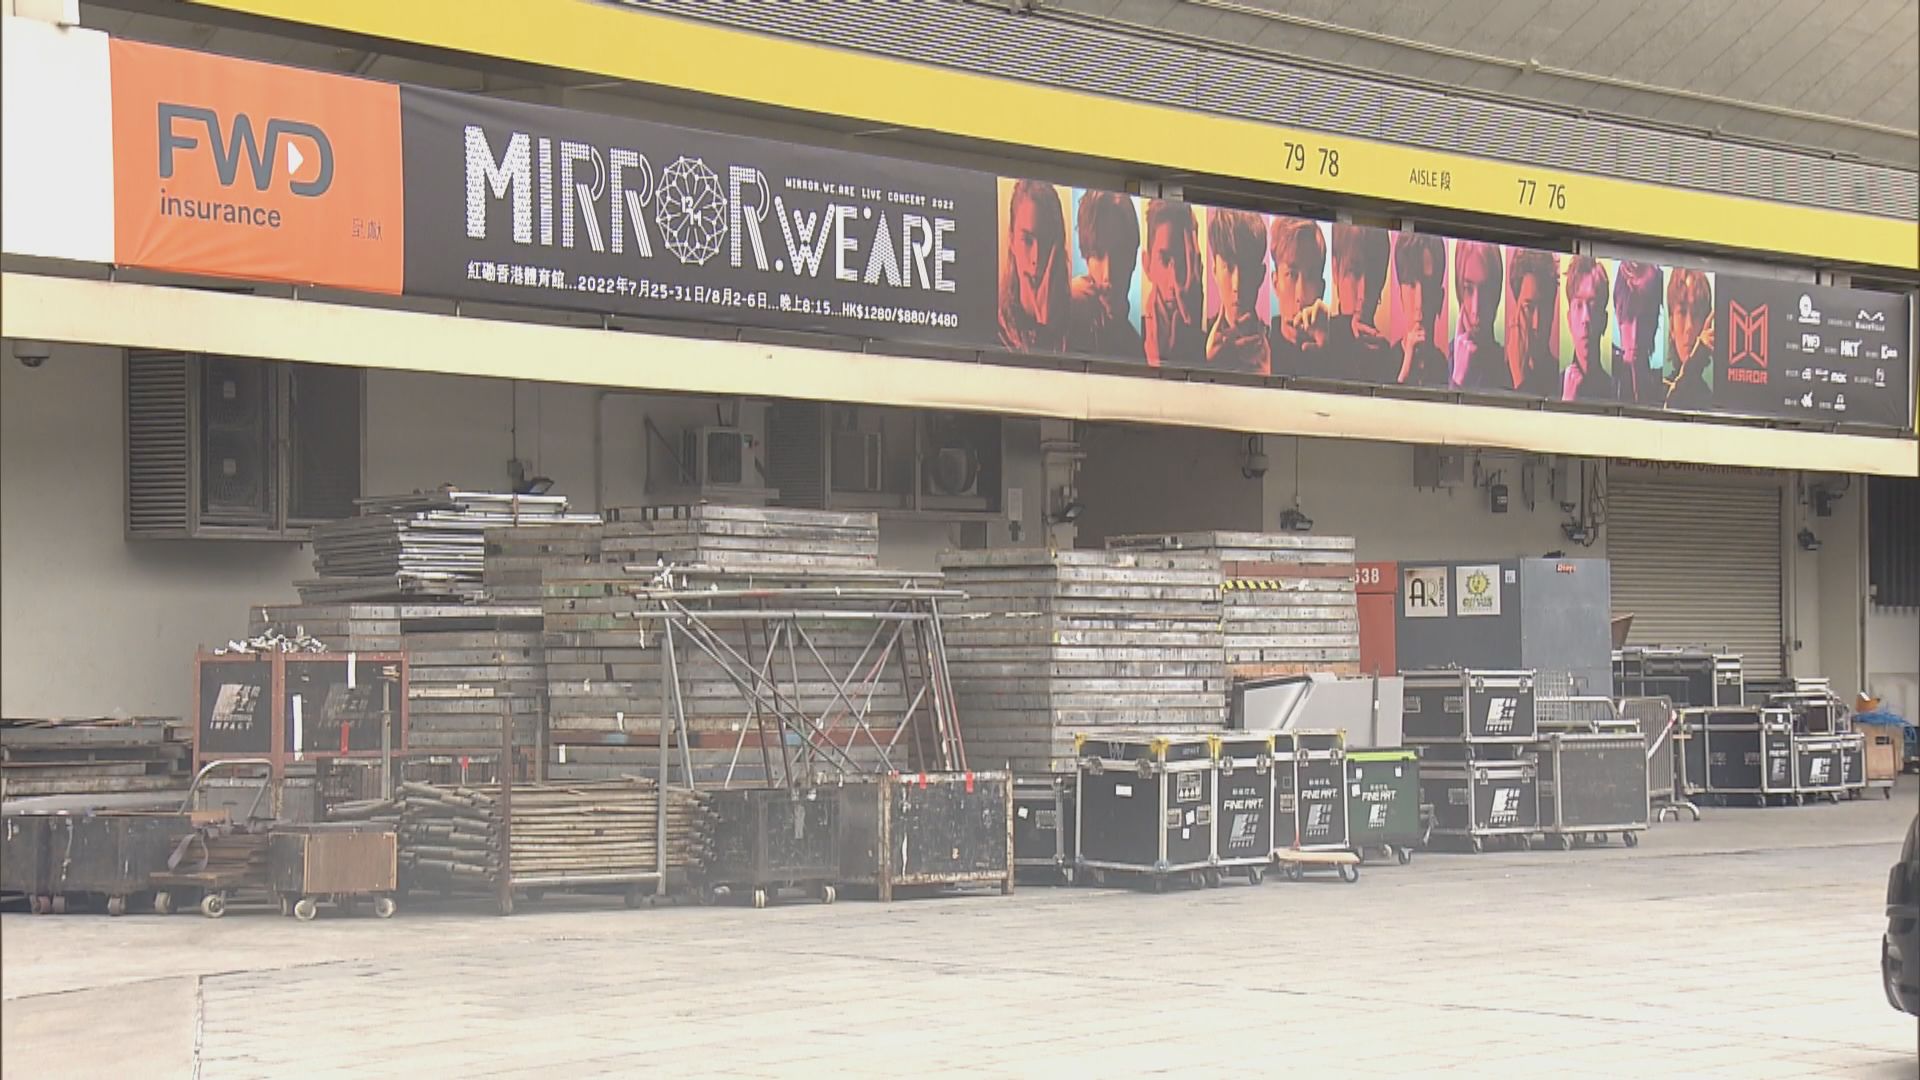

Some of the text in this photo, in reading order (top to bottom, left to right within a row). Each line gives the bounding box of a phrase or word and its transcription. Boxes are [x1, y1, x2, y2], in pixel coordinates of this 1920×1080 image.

[157, 102, 334, 197] FWD
[1284, 142, 1340, 177] 79 78
[1409, 167, 1451, 191] AISLE 段
[161, 188, 281, 228] insurance
[862, 187, 882, 200] LIVE
[887, 192, 926, 207] CONCERT
[1518, 179, 1566, 210] 77 76
[1728, 368, 1768, 385] MIRROR
[210, 721, 252, 731] IMPACT
